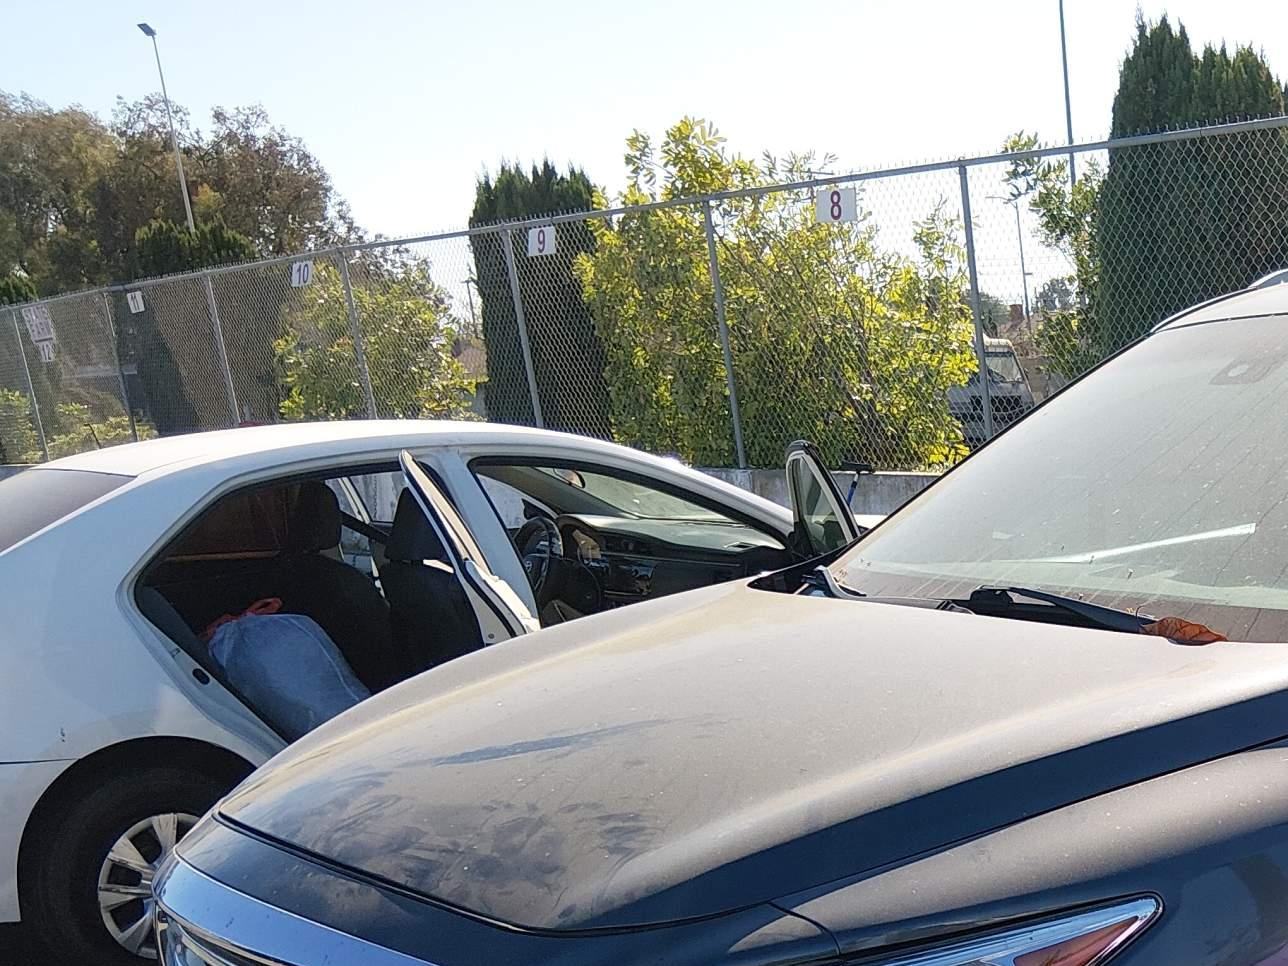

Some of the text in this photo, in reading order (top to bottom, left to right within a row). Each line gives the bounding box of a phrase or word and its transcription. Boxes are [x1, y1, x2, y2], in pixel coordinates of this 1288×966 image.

[830, 190, 841, 220] 8
[537, 229, 546, 254] 9
[297, 263, 310, 284] 10
